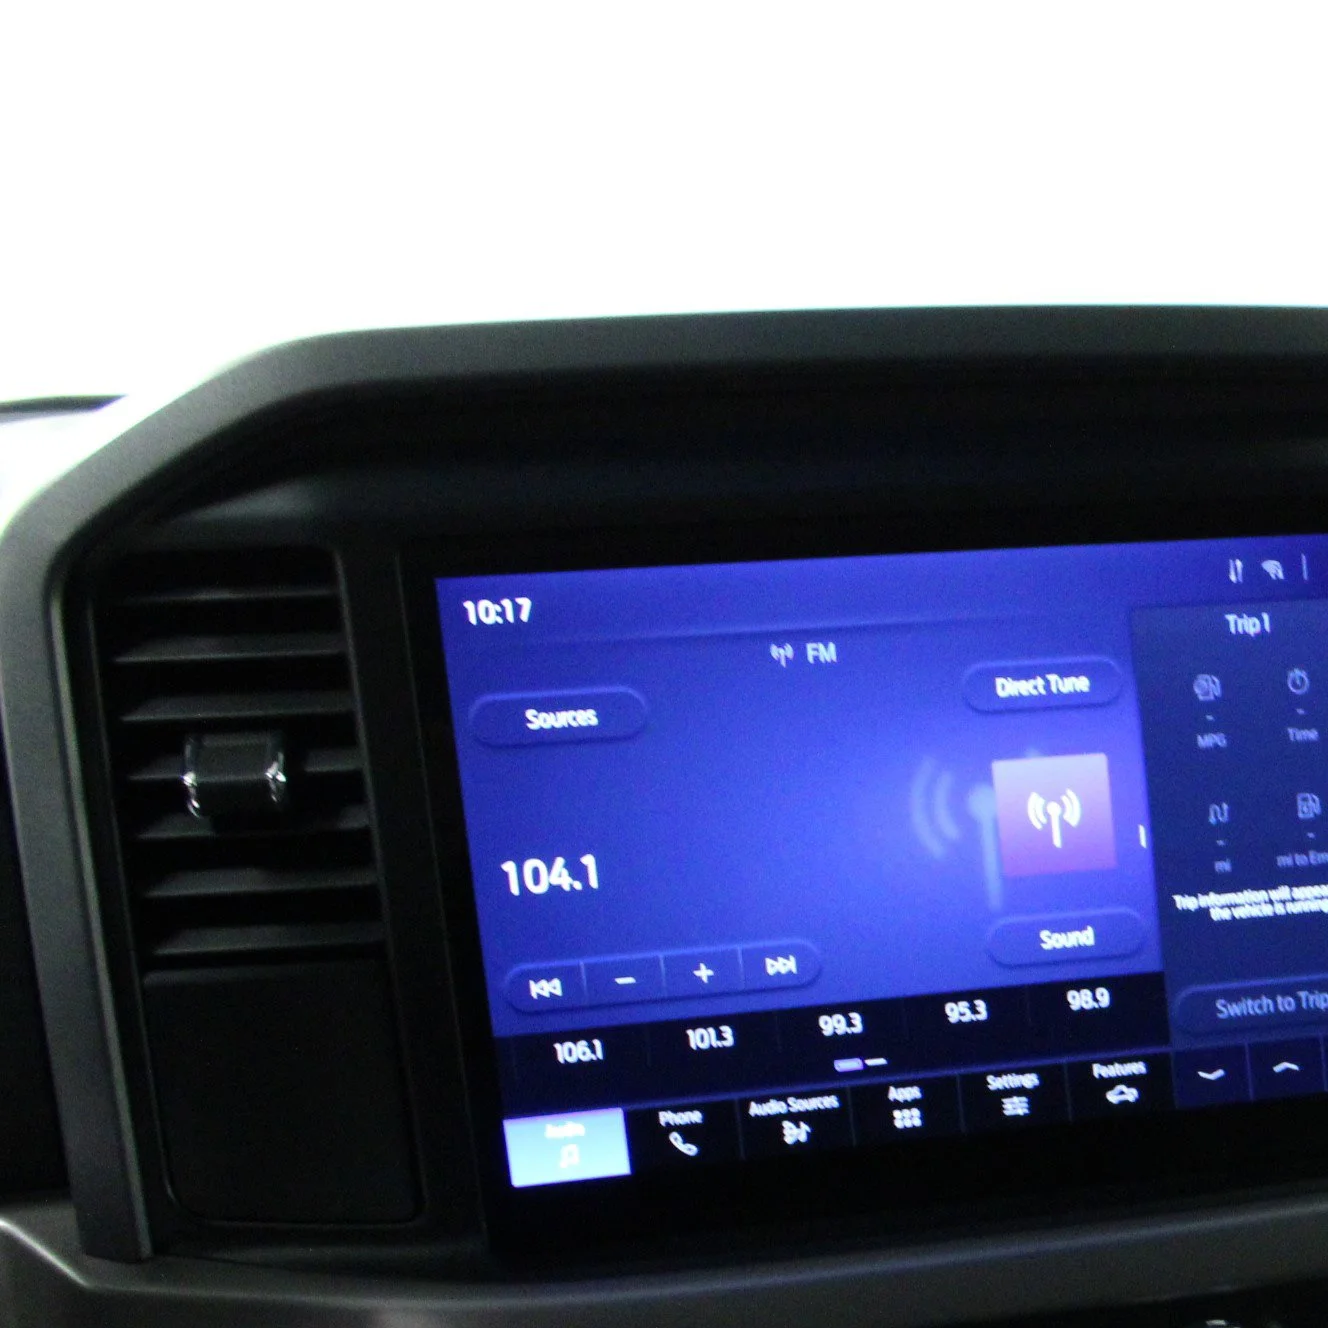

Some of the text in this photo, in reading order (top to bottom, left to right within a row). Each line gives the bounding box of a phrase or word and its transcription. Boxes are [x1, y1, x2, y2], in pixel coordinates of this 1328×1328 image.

[462, 596, 533, 626] 10:17
[1224, 613, 1271, 637] Trip 1
[805, 641, 837, 664] FM
[995, 673, 1091, 699] Direct Tune
[524, 708, 599, 731] Sources
[500, 853, 599, 897] 104.1
[1039, 925, 1096, 951] Sound
[1066, 986, 1111, 1011] 98.9
[1215, 994, 1275, 1019] Switch
[1275, 994, 1296, 1013] to
[818, 1011, 864, 1037] 99.3
[944, 999, 988, 1024] 95.3
[685, 1025, 735, 1051] 101.3
[553, 1038, 604, 1064] 106.1
[658, 1110, 703, 1127] Phone
